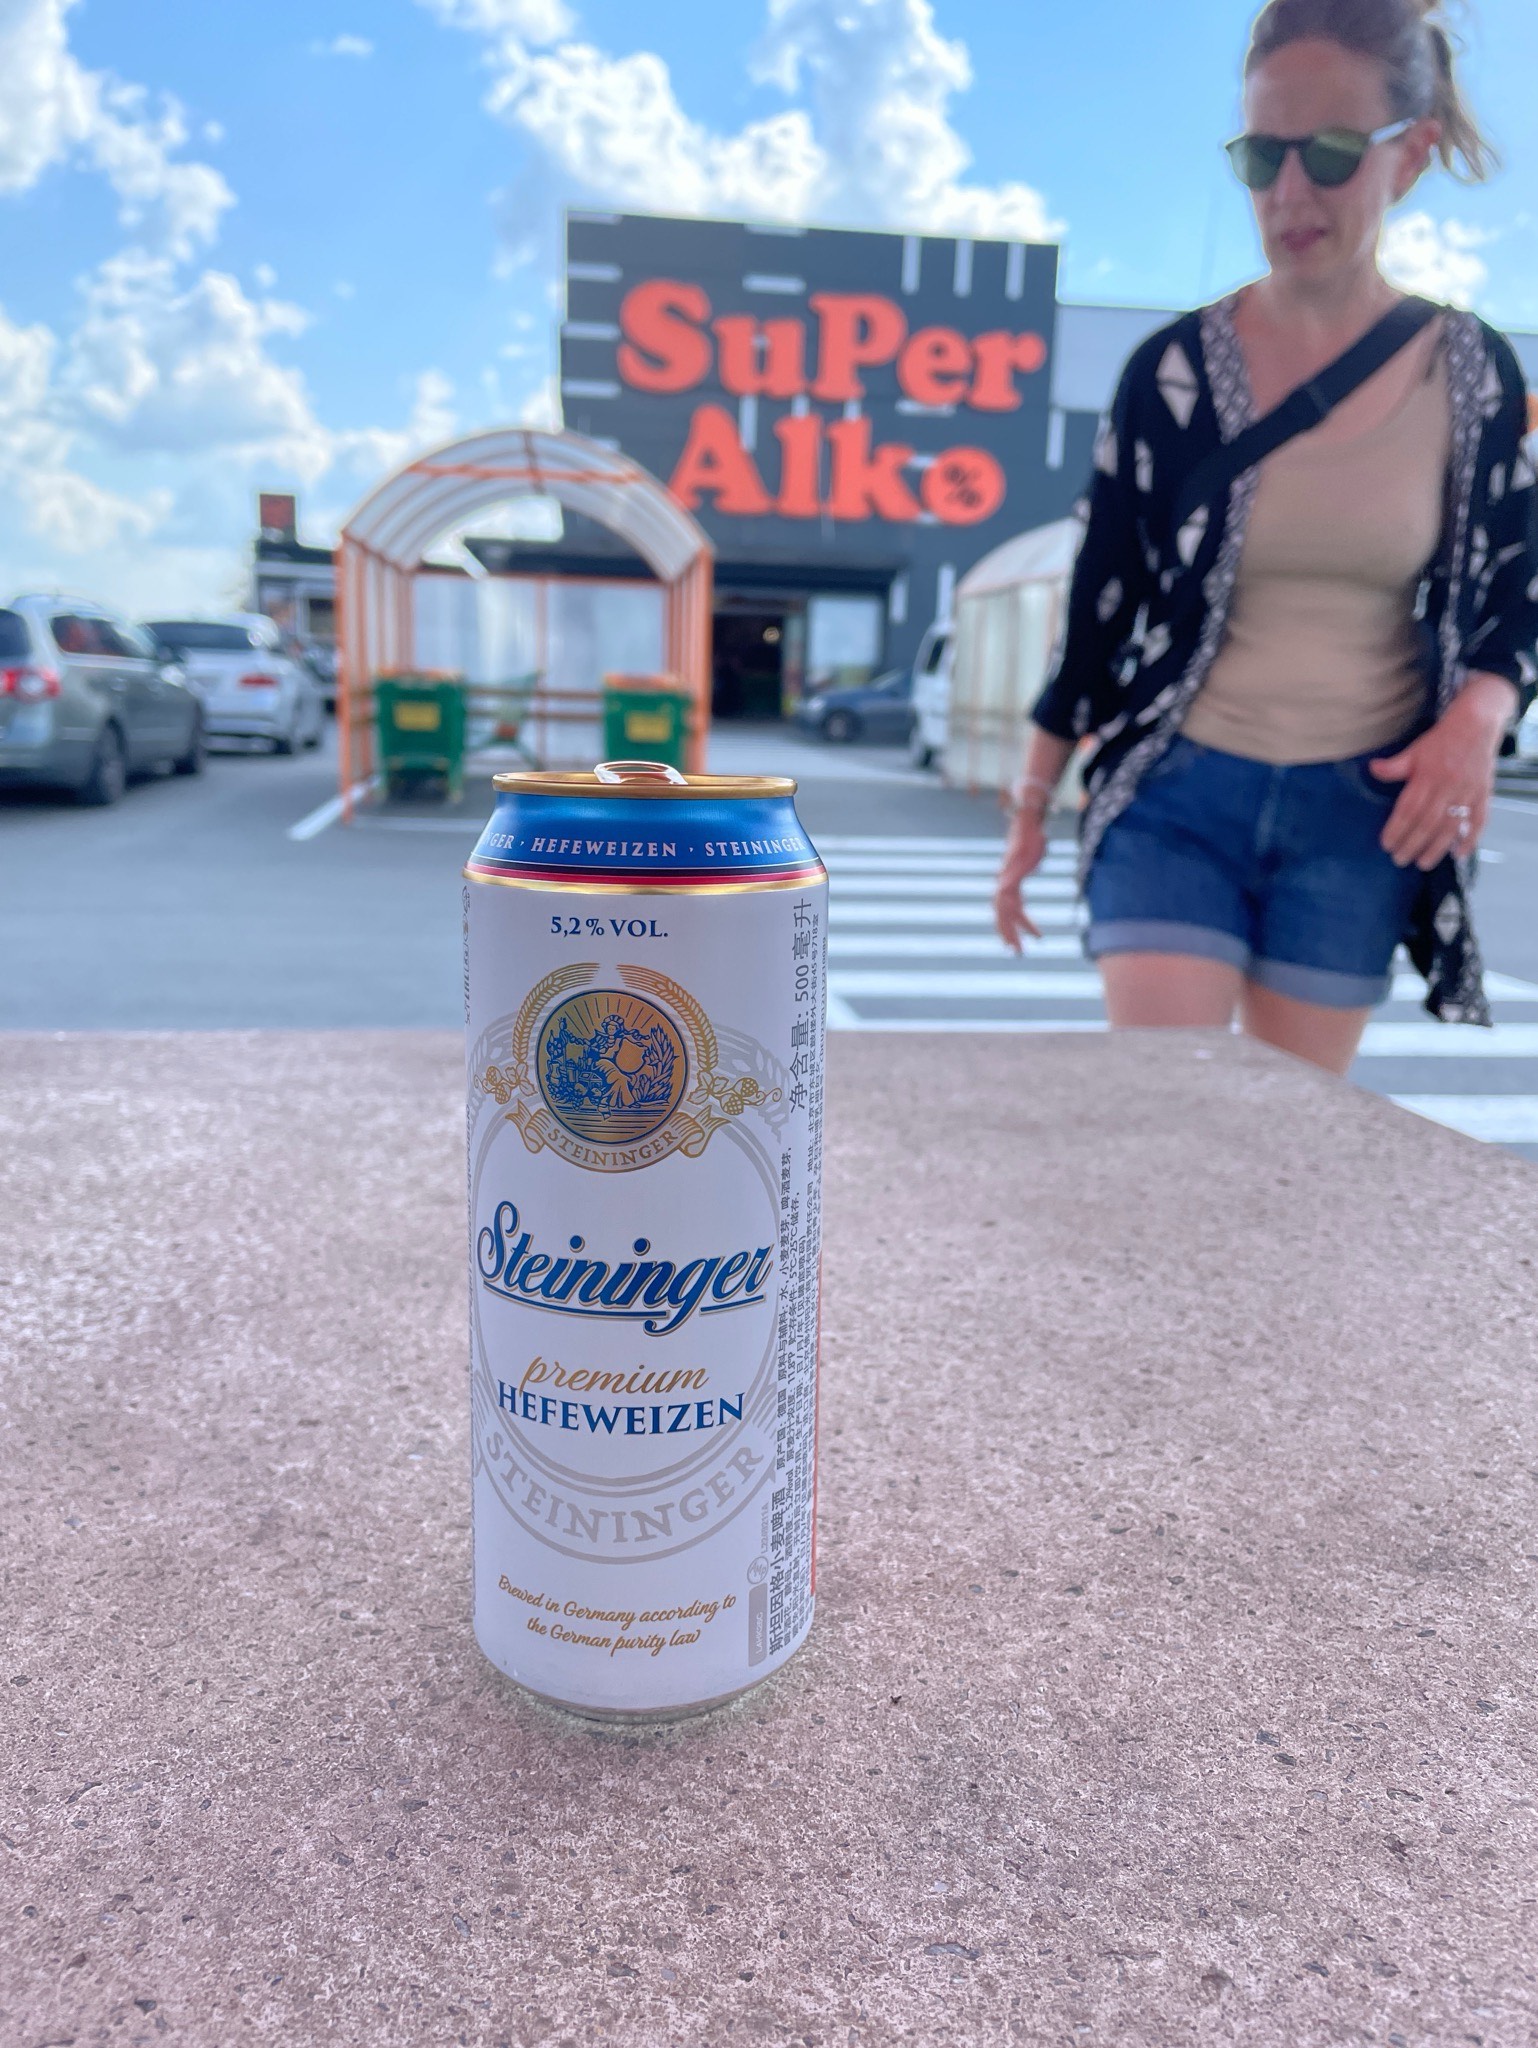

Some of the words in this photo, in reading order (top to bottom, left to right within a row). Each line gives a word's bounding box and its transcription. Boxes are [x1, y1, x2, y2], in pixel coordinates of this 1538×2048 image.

[530, 837, 676, 857] HEFEWEIZEN
[705, 837, 806, 857] STEININGER
[609, 919, 669, 937] VOL.
[548, 1128, 678, 1166] STEININGER
[477, 1200, 775, 1337] Steininger
[518, 1356, 710, 1398] premium
[498, 1379, 745, 1435] HEFEWEIZEN
[486, 1431, 764, 1543] STEININGER
[769, 1487, 786, 1656] 斯坦因格小麦啤酒
[498, 1574, 543, 1608] Brewed
[545, 1597, 561, 1613] in
[563, 1601, 636, 1631] Germany
[639, 1599, 720, 1623] according
[722, 1593, 737, 1609] to
[526, 1617, 548, 1635] the
[550, 1623, 611, 1648] German
[610, 1632, 666, 1657] purity
[669, 1629, 701, 1647] law
